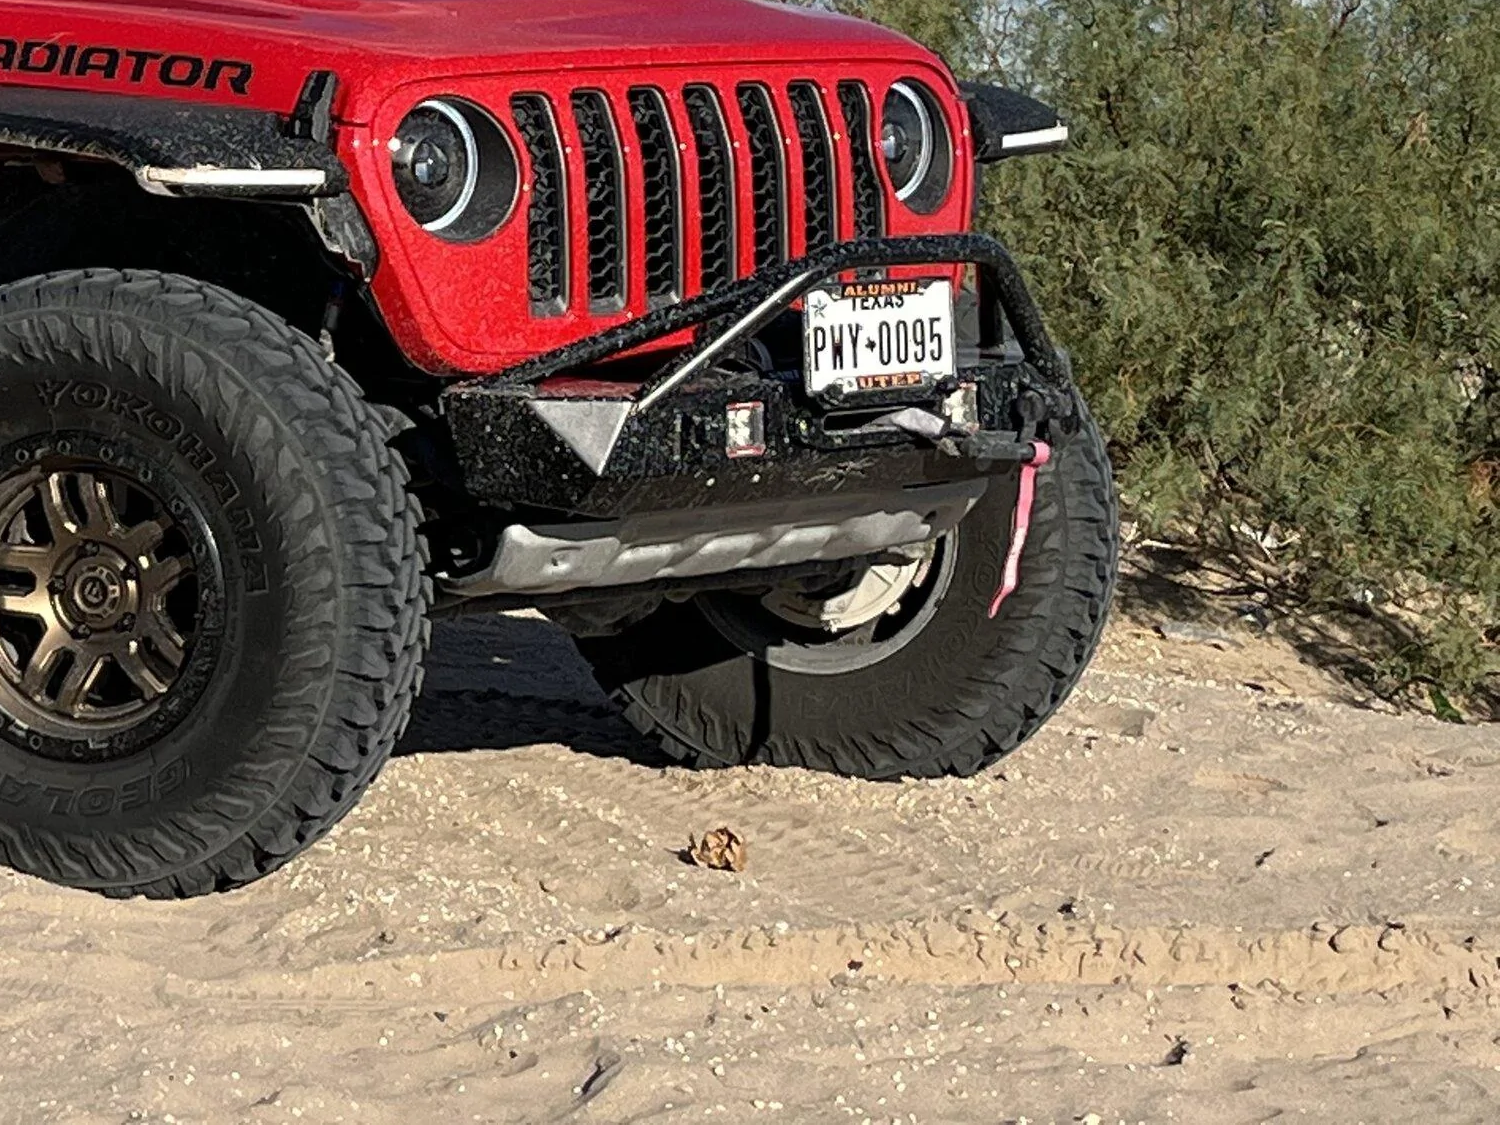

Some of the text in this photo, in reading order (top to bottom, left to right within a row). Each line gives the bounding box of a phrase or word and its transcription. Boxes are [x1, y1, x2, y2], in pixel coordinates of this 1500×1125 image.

[844, 282, 917, 296] ALUMNI
[851, 296, 904, 311] TEXAS
[34, 379, 270, 595] YOKOHAMA
